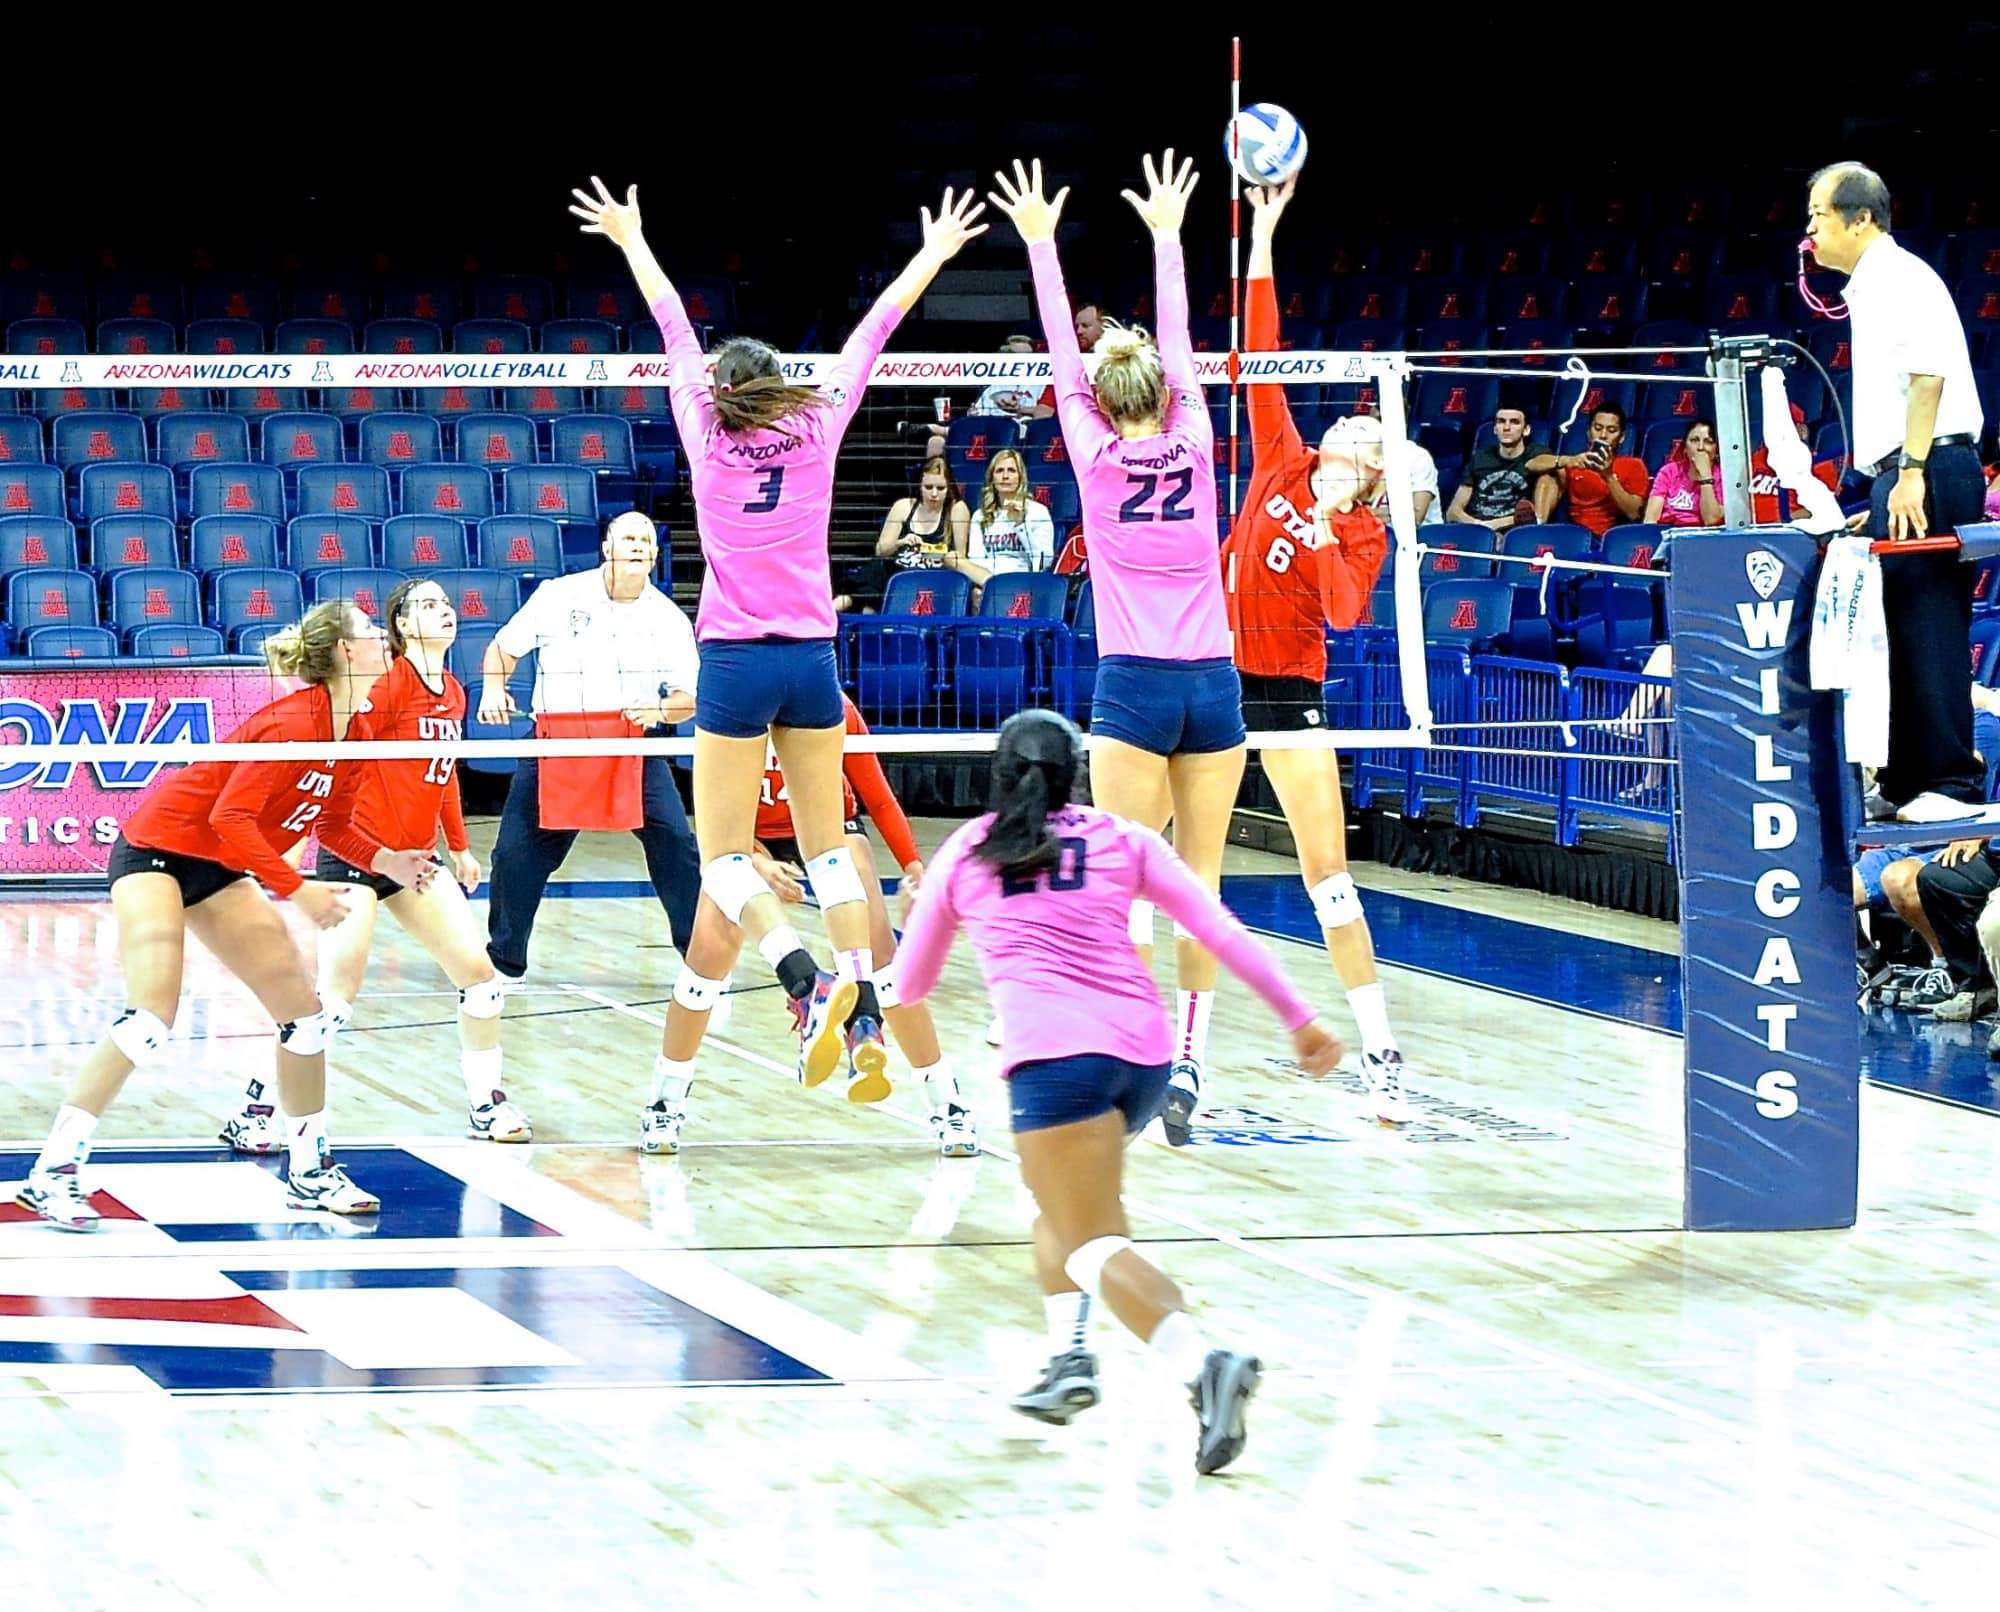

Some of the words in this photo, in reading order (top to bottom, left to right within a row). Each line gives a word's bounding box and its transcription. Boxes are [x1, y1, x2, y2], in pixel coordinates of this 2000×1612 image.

[103, 363, 293, 379] ARIZONAWILDCATS
[354, 362, 568, 379] ARIZONAVOLLEYBALL
[875, 361, 1053, 378] ARIZONAVOLLEYB
[742, 465, 785, 513] 3
[1119, 467, 1194, 523] 22
[1266, 537, 1295, 573] 6
[424, 756, 457, 786] 19
[280, 801, 323, 833] 12
[1735, 599, 1801, 1121] WILDCATS
